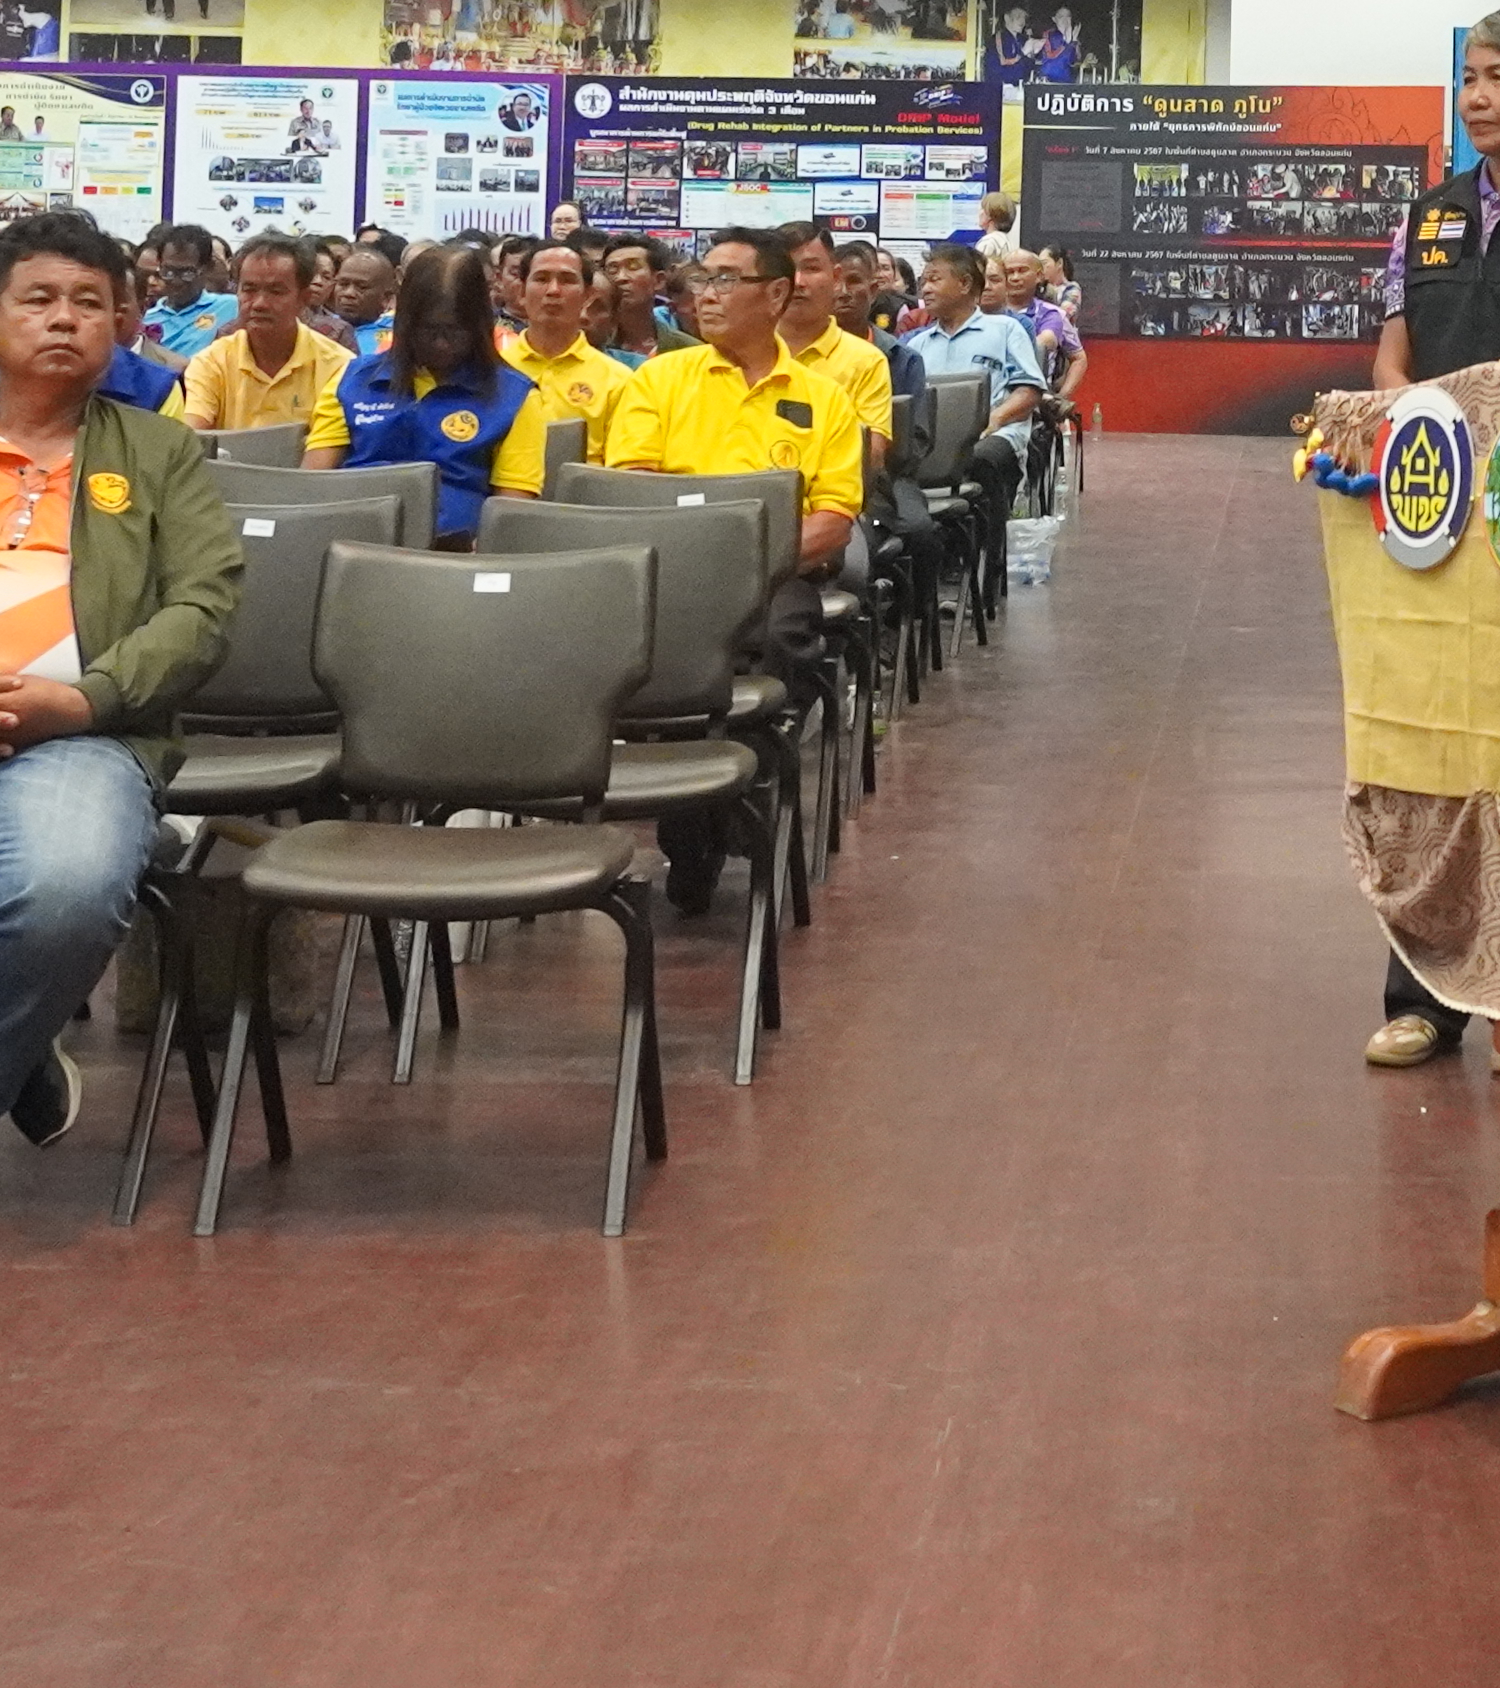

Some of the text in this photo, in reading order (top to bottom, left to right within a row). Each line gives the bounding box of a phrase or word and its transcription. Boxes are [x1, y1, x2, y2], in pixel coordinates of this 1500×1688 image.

[618, 85, 877, 105] สำนักงานคุมประพฤติจังหวัดขอนแก่น
[1036, 92, 1135, 116] ปฏิบัติการ
[687, 121, 983, 135] (Drug Rehab Integration of Partners in Probation Services)
[1421, 245, 1449, 266] ปค.
